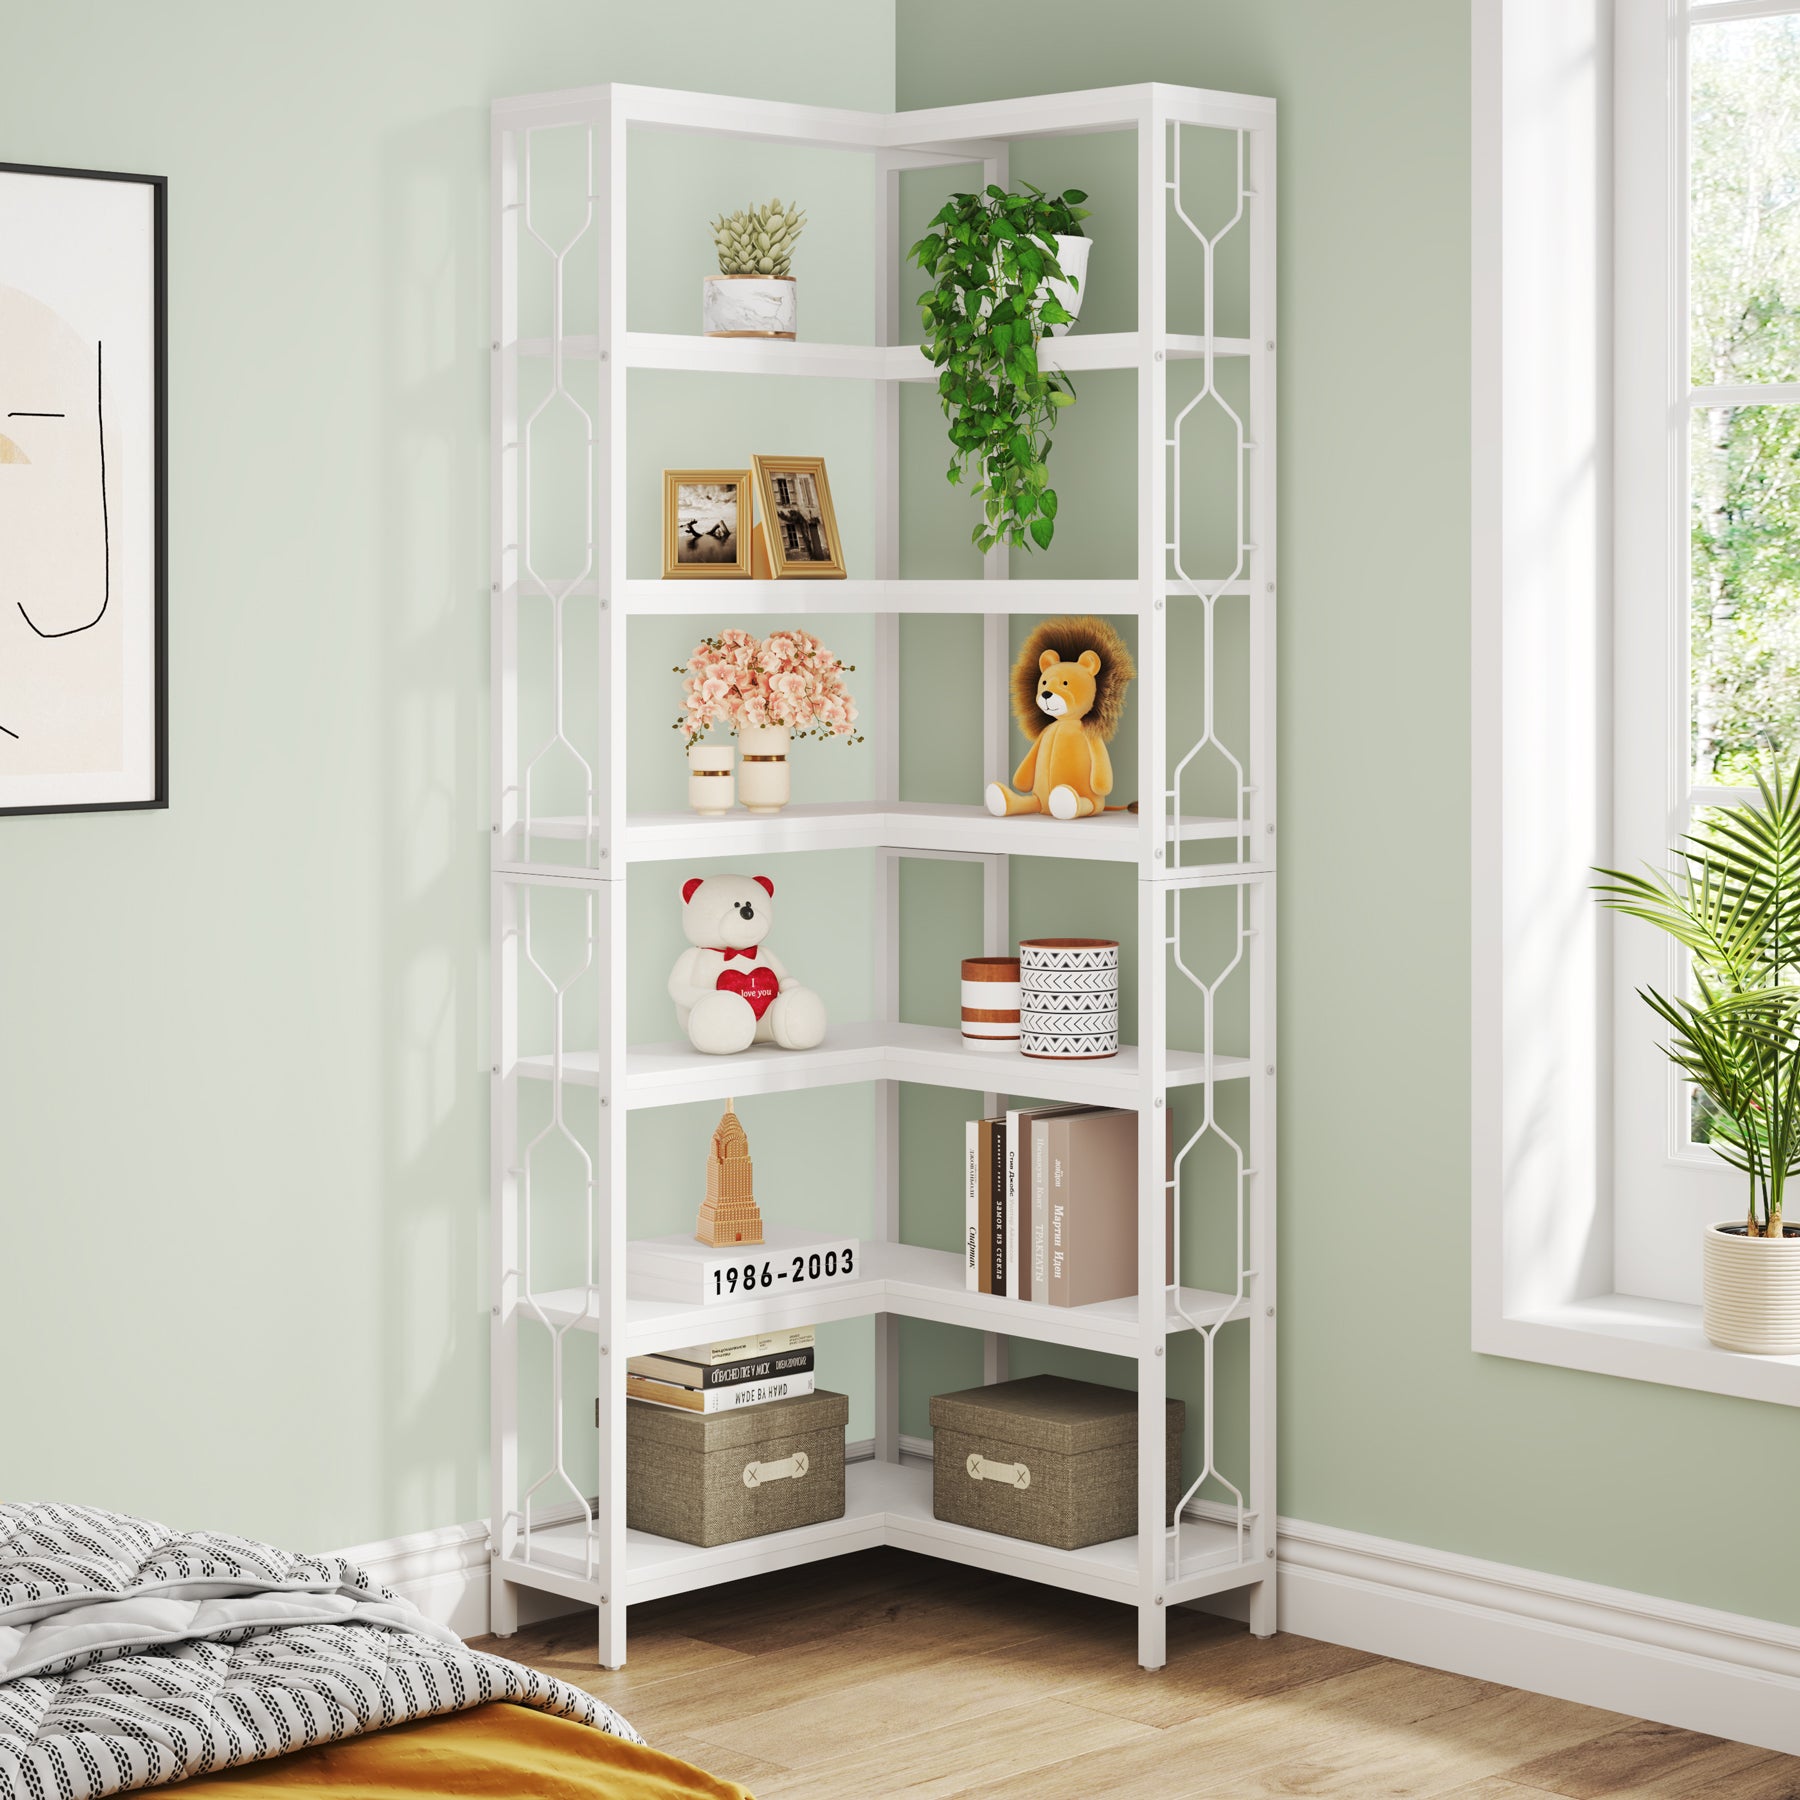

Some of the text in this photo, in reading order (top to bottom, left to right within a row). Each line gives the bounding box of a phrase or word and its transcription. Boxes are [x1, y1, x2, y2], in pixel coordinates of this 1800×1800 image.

[741, 989, 772, 999] love you
[751, 977, 755, 988] I
[967, 1226, 977, 1269] Спартак
[996, 1233, 1003, 1245] из
[1035, 1224, 1044, 1282] ТРАКТАТЫ
[1052, 1204, 1064, 1279] Мартин Иден
[714, 1248, 854, 1296] 1986-2003
